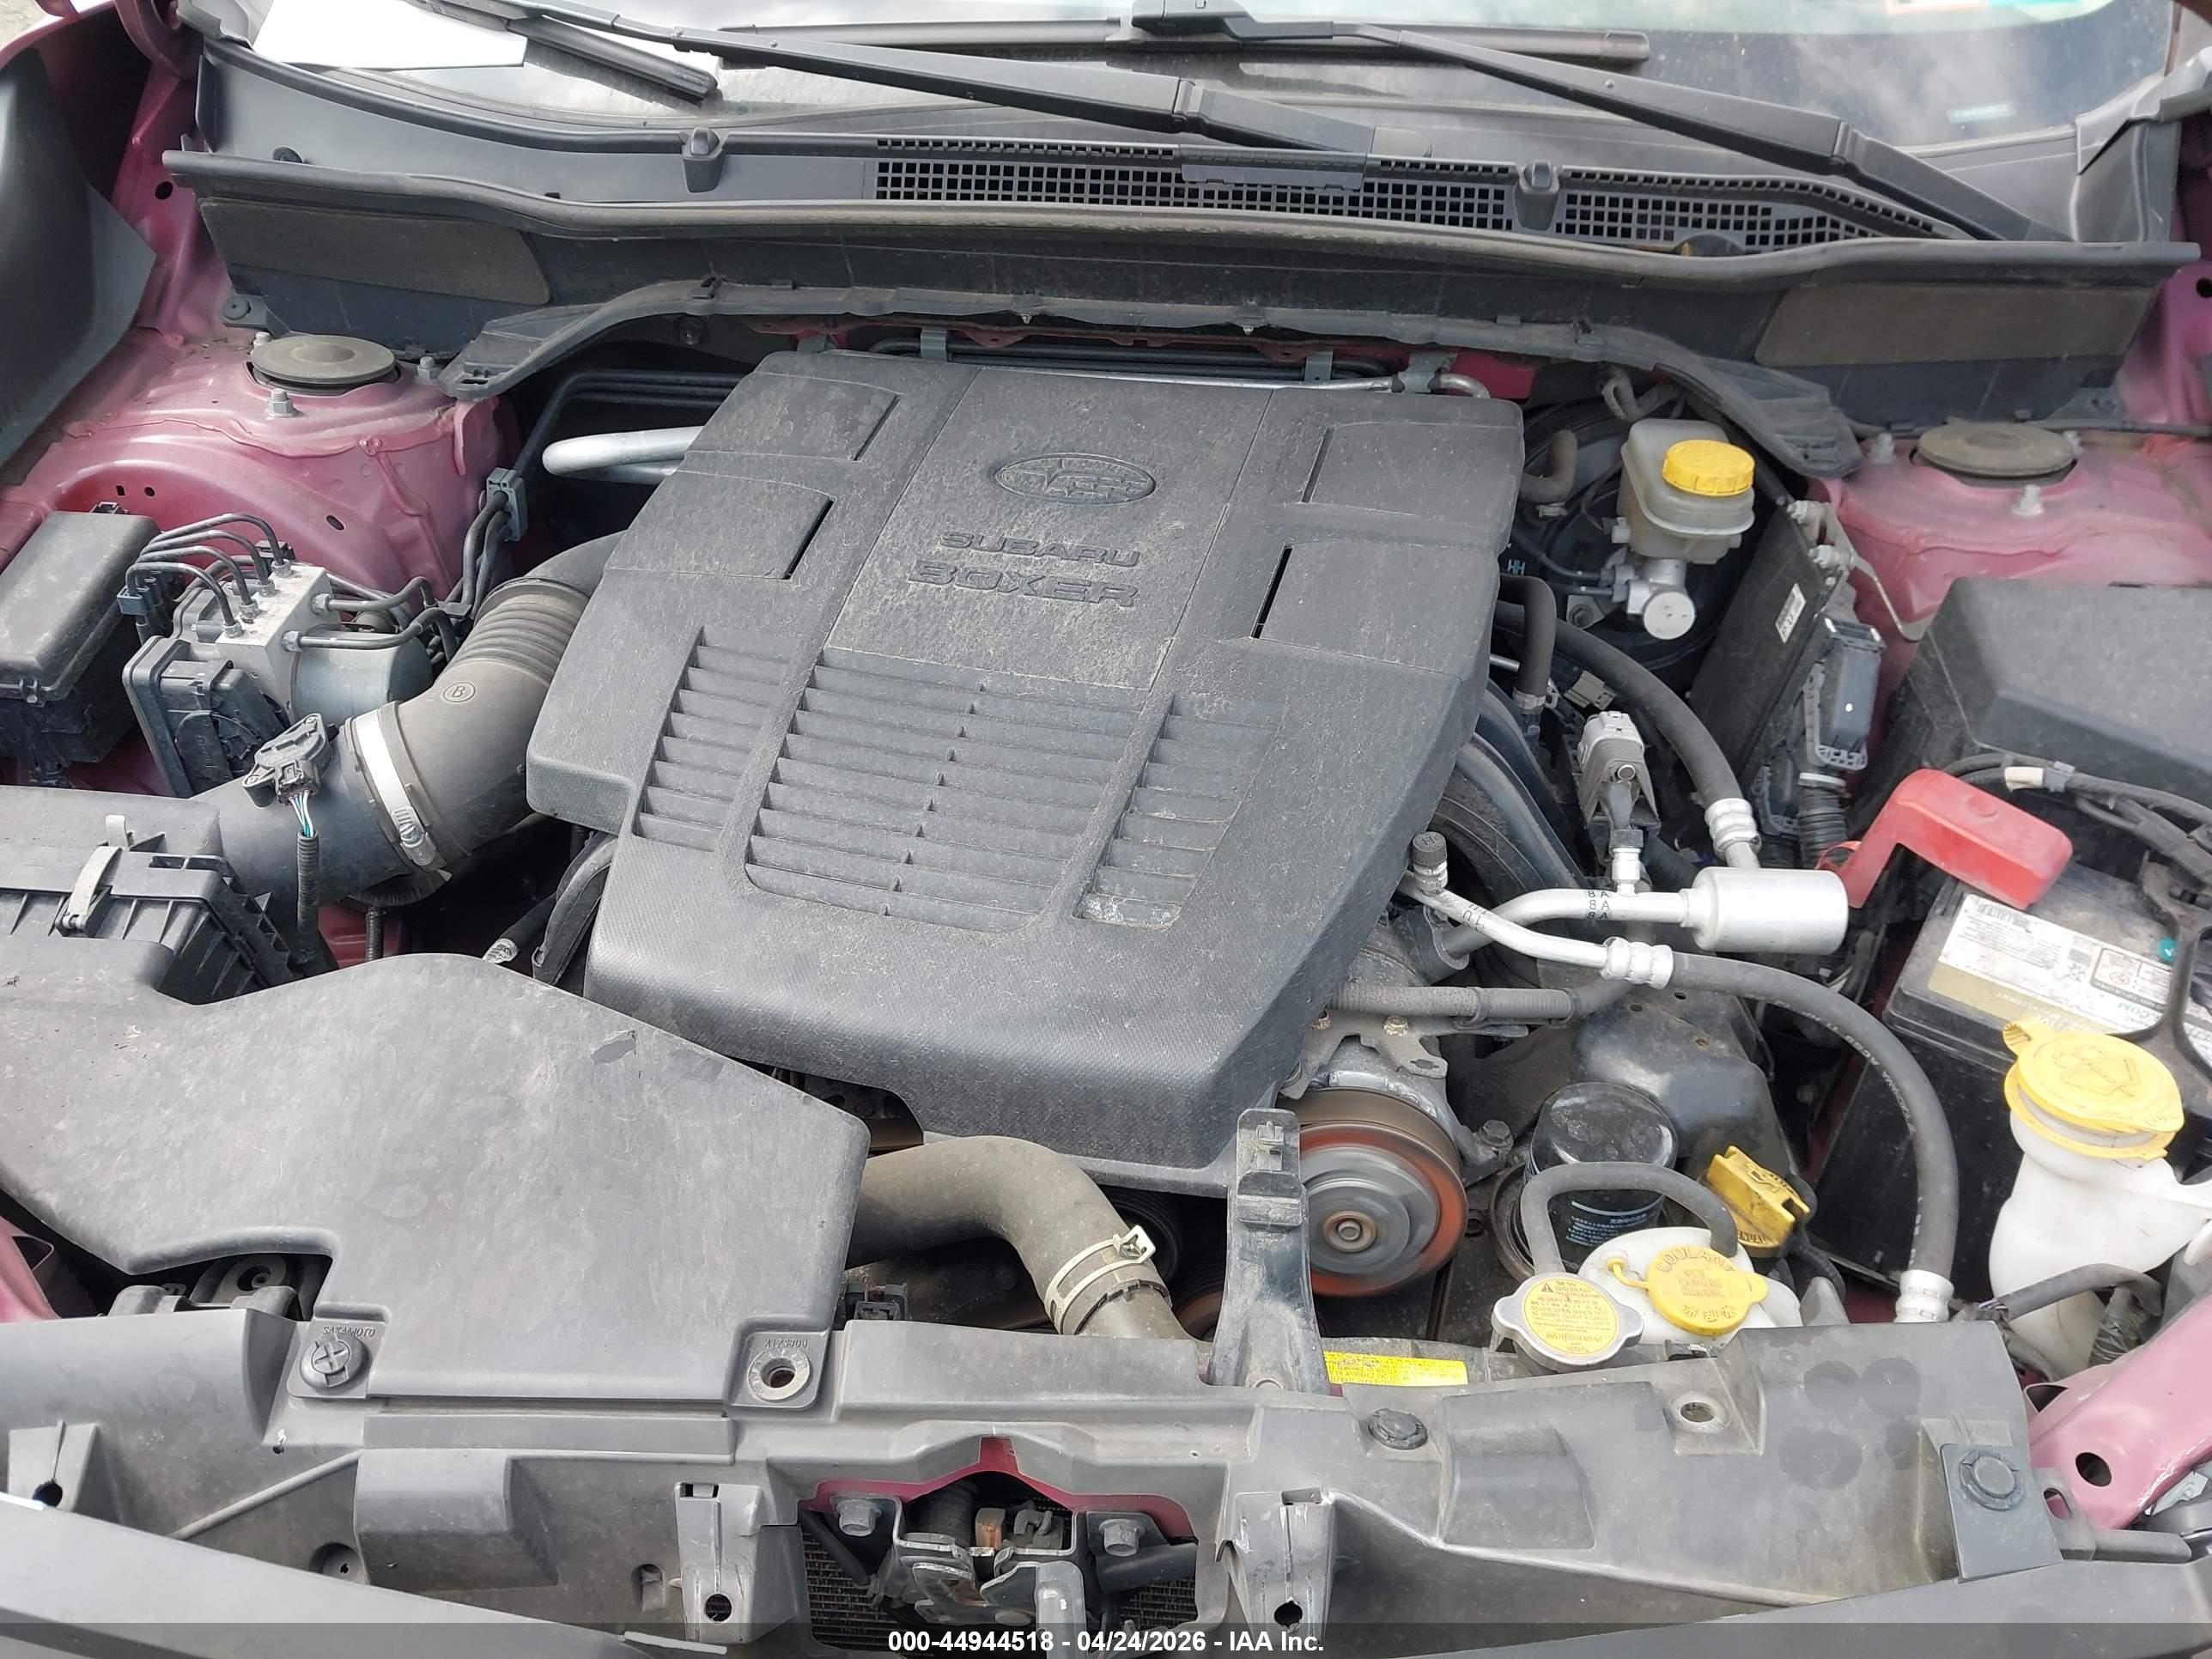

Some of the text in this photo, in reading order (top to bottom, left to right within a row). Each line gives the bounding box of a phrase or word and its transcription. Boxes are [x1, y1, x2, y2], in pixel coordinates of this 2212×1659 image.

[939, 532, 1140, 568] SUBARU
[907, 560, 1139, 607] BOXER
[452, 686, 465, 698] B
